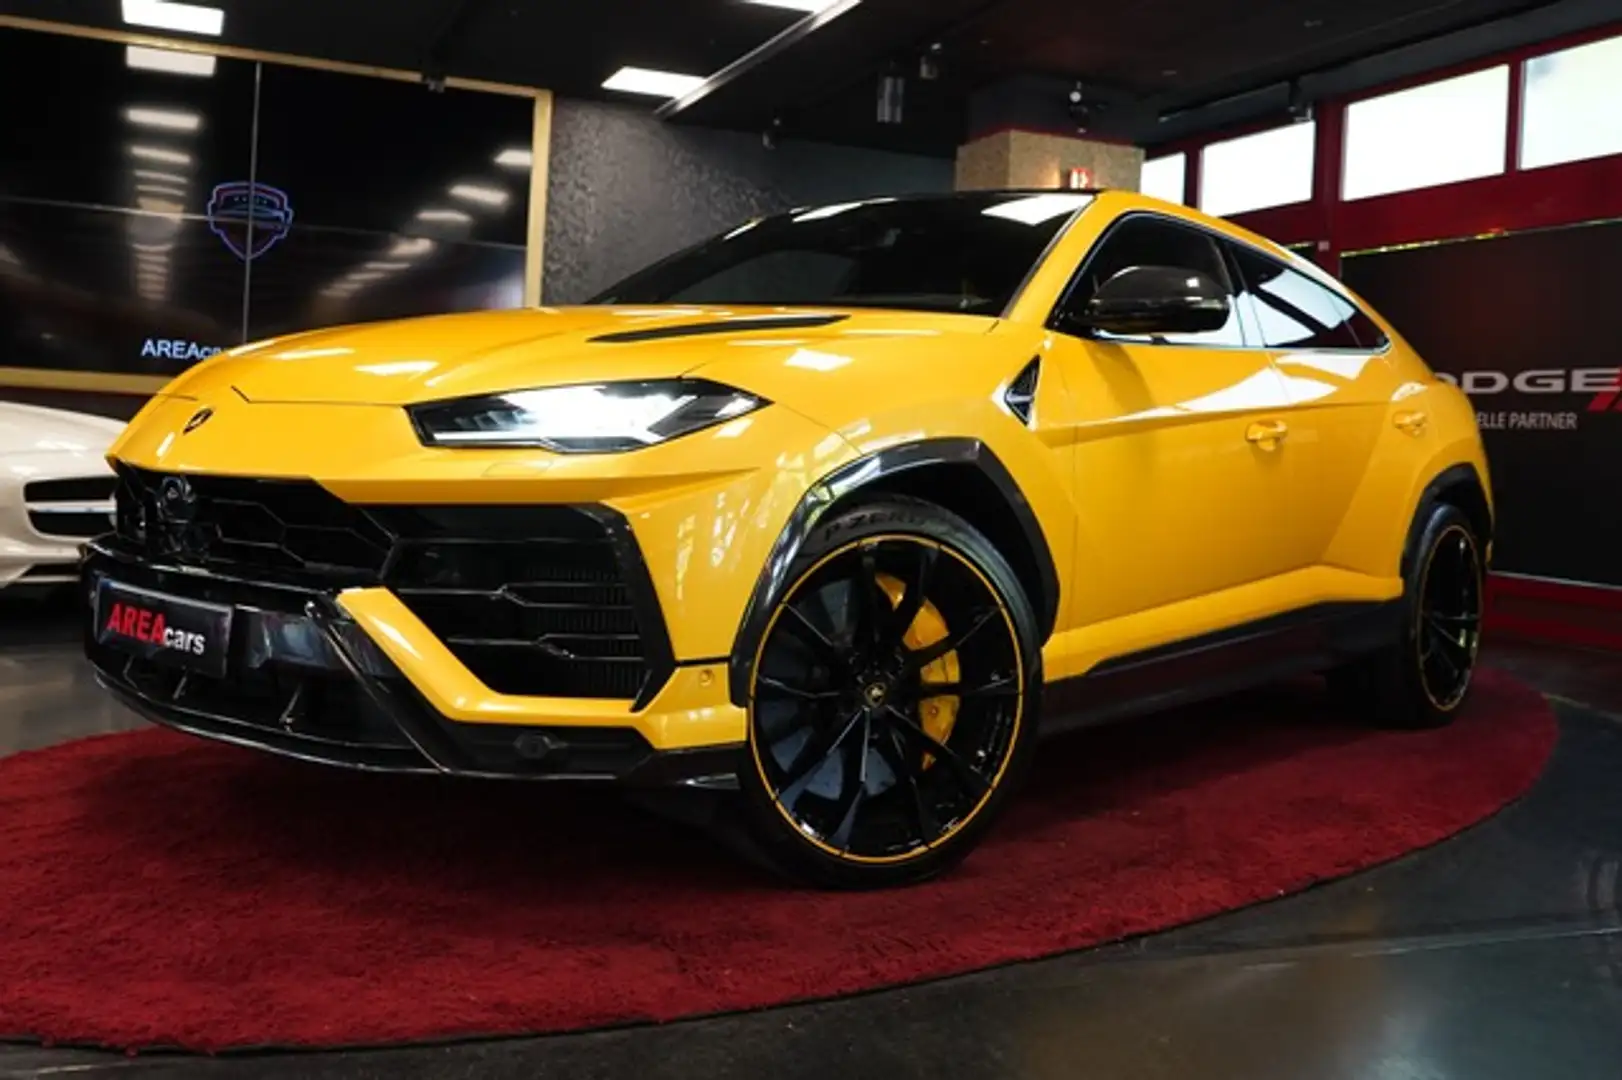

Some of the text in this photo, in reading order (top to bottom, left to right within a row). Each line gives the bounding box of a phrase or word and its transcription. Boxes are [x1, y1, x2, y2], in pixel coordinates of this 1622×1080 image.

[1476, 411, 1578, 430] ELLE PARTNER
[105, 603, 206, 655] AREAcars
